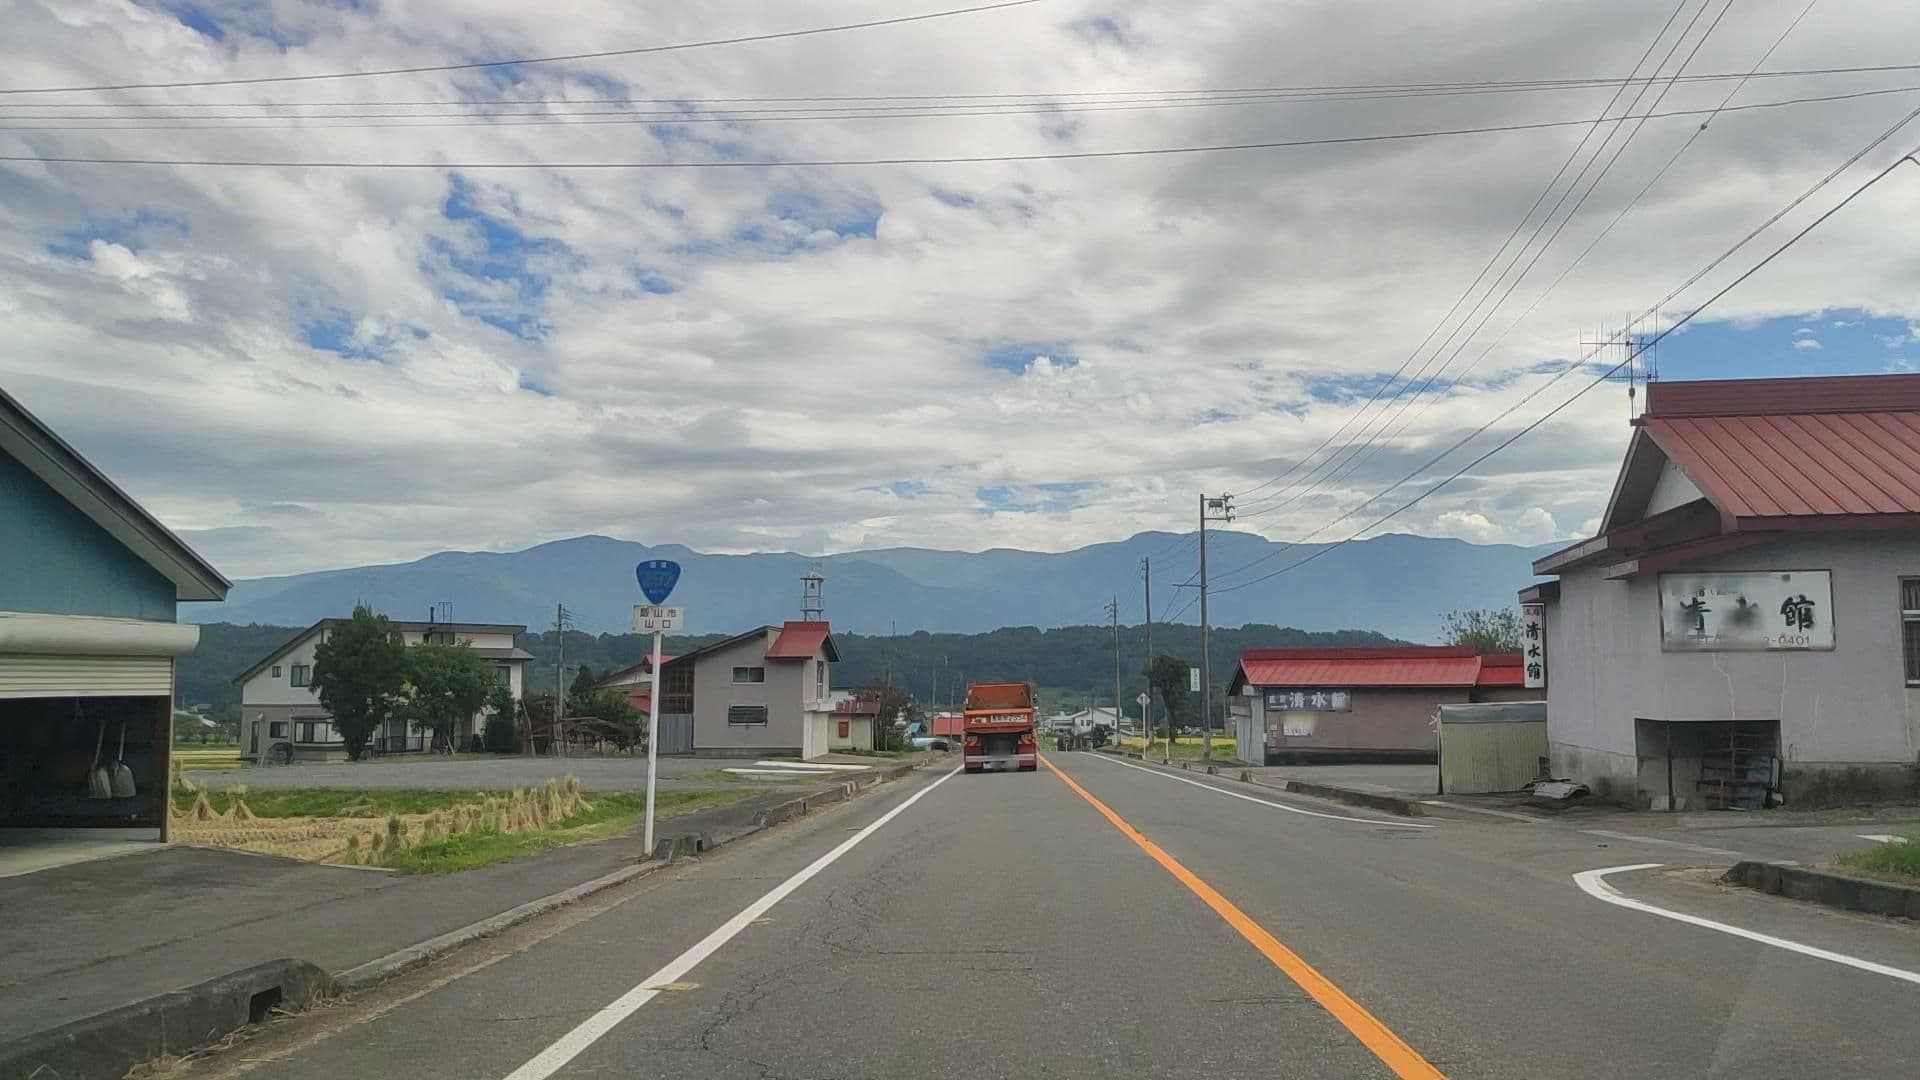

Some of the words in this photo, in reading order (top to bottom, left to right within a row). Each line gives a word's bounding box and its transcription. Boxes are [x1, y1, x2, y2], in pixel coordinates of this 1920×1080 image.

[644, 619, 671, 628] 山口
[1525, 621, 1541, 680] 清水館
